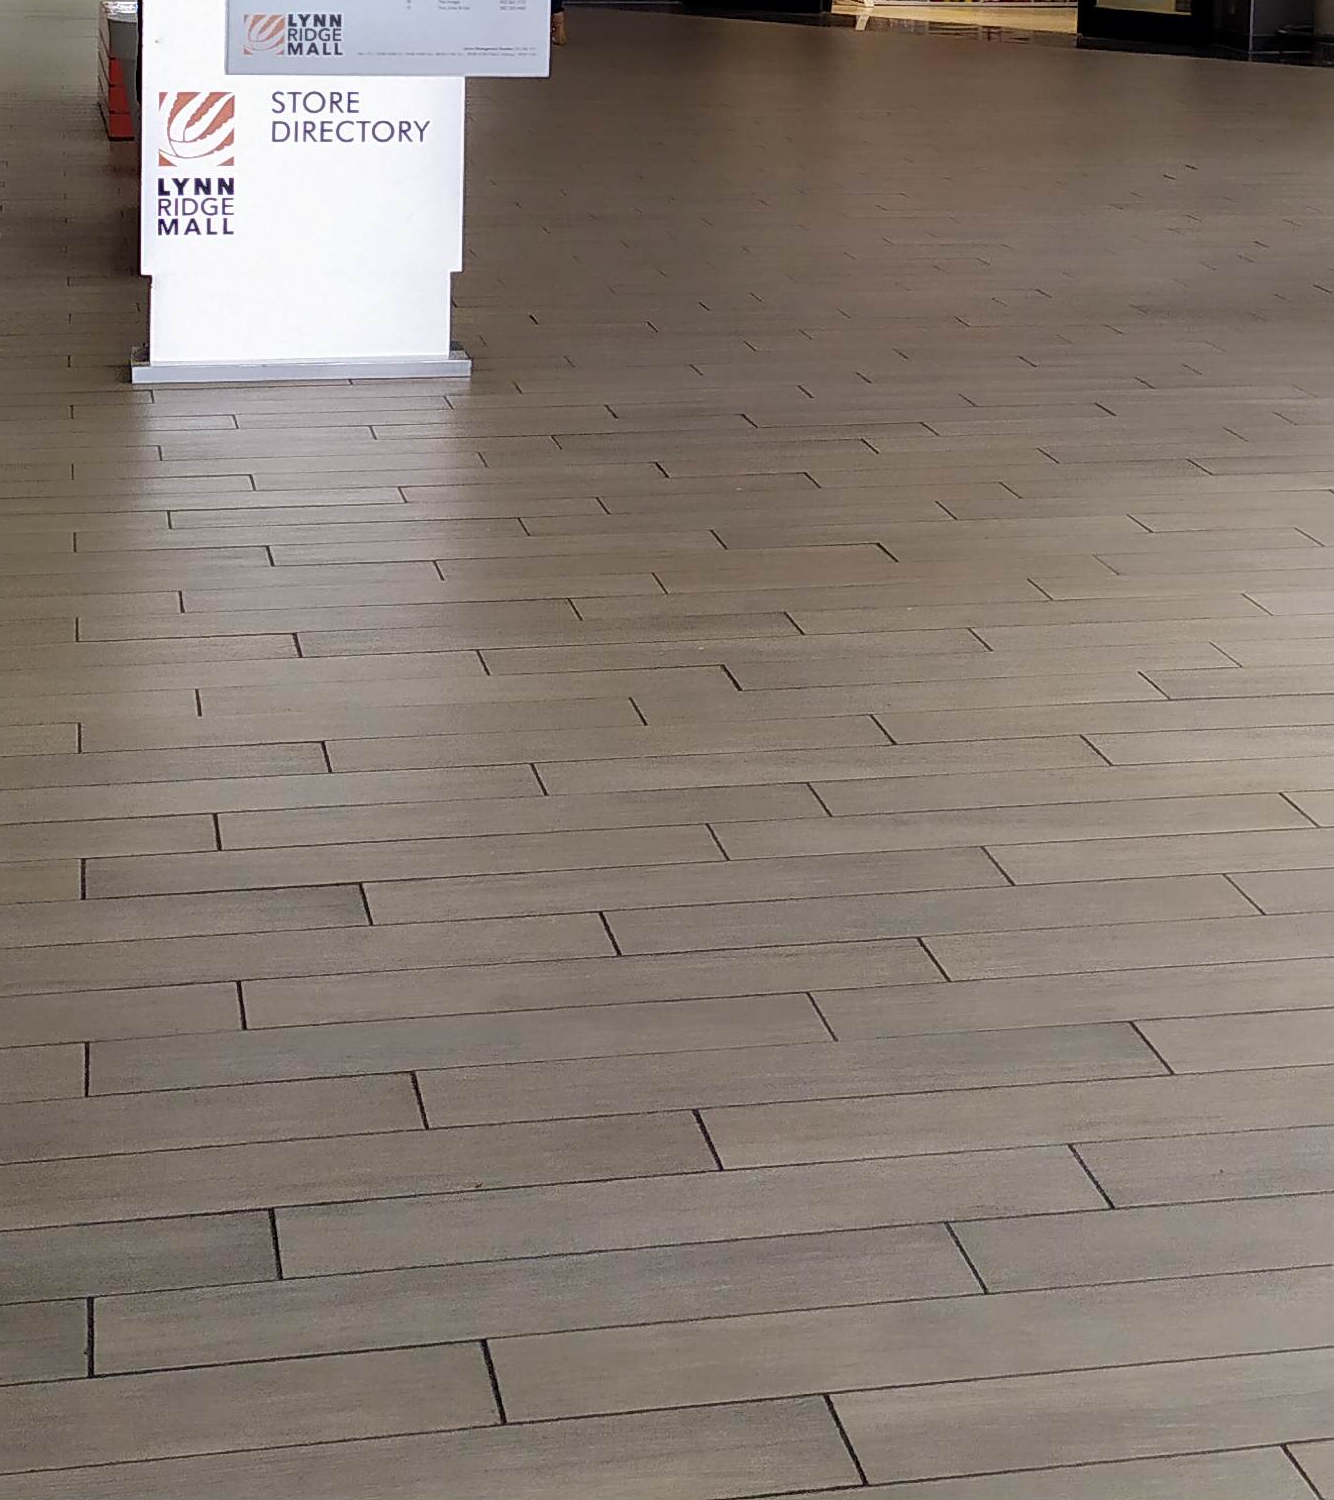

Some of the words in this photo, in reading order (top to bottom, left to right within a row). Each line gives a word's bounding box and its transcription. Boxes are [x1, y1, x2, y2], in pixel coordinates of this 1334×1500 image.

[287, 13, 342, 28] LYNN
[288, 28, 342, 42] RIDGE
[288, 42, 343, 56] MALL
[271, 91, 360, 114] STORE
[271, 120, 430, 143] DIRECTORY
[157, 177, 235, 196] LYNN
[157, 197, 234, 216] RIDGE
[157, 218, 235, 236] MALL
